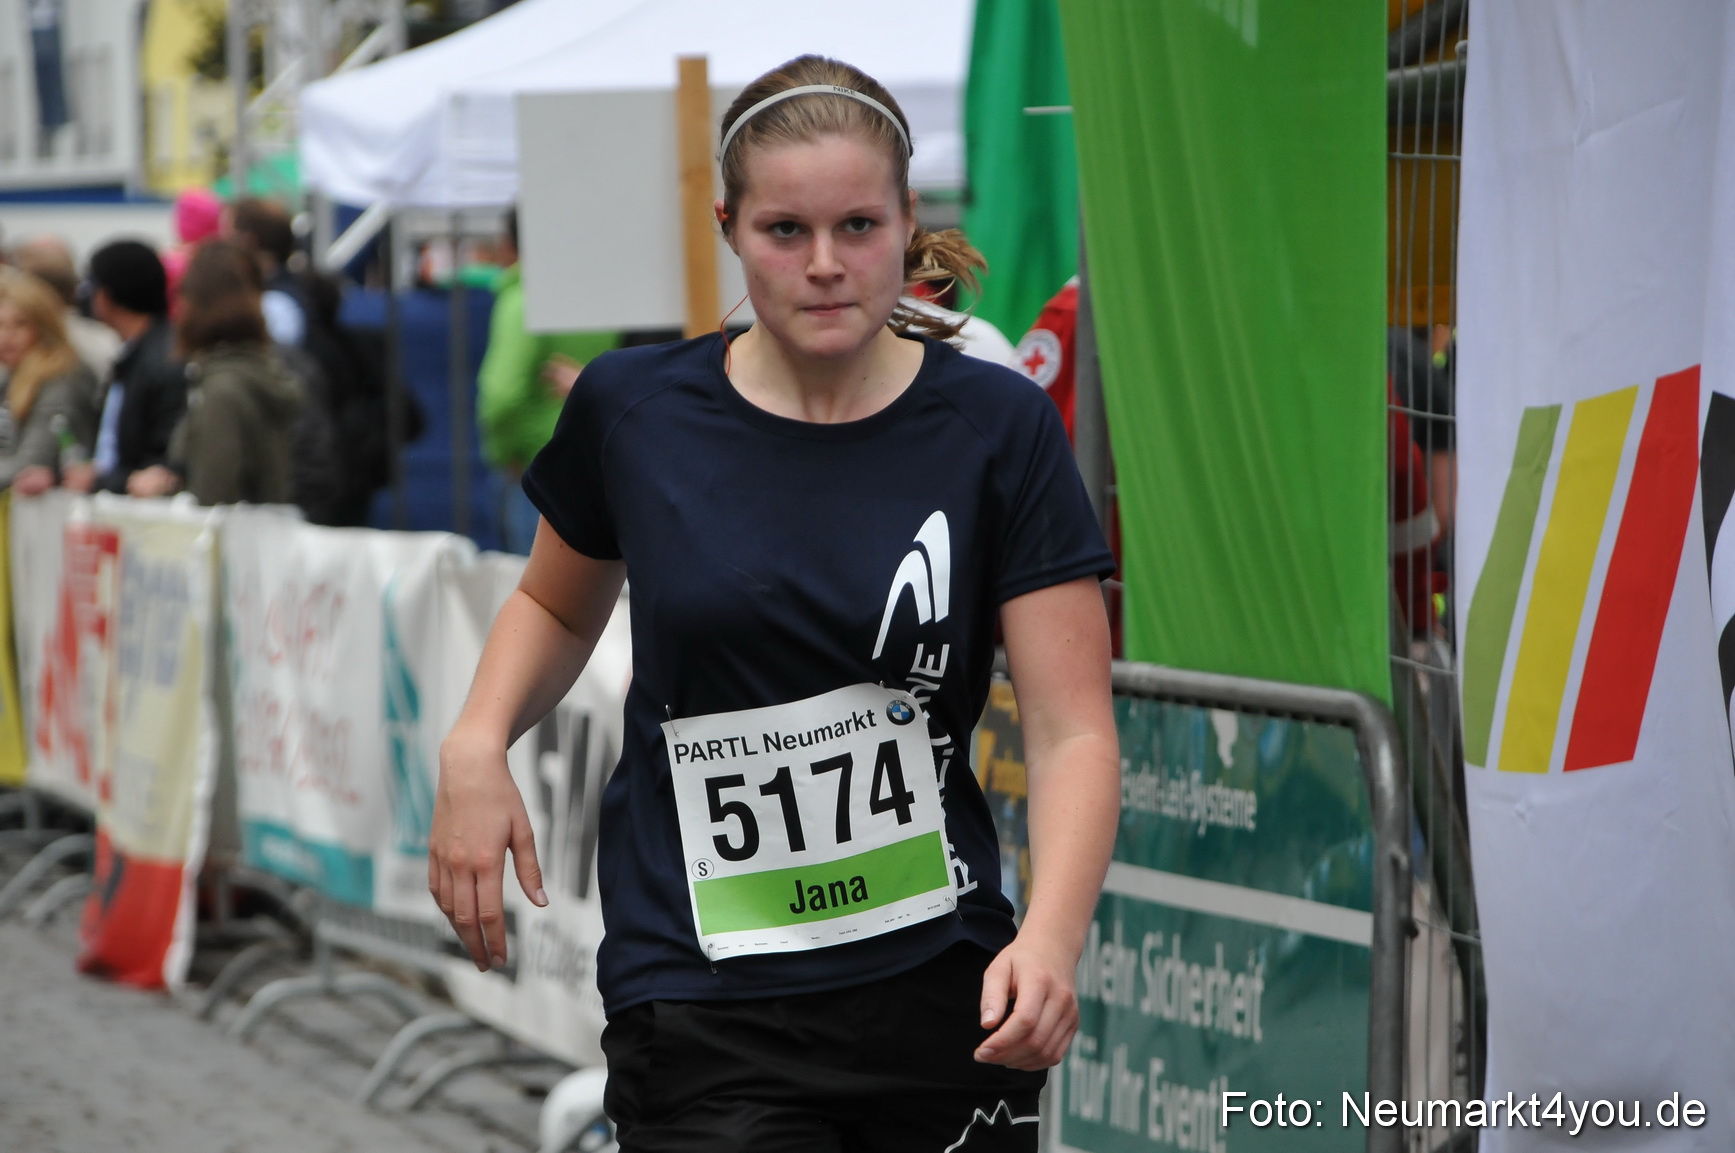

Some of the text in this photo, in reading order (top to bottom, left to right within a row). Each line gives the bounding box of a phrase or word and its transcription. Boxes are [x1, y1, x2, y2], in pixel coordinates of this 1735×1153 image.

[833, 86, 857, 95] NIKE
[674, 709, 877, 764] PARTL Neumarkt
[704, 739, 916, 862] 5174
[789, 875, 869, 915] Jana
[1140, 930, 1264, 1043] Sicherheit
[1110, 1043, 1145, 1136] Ihr
